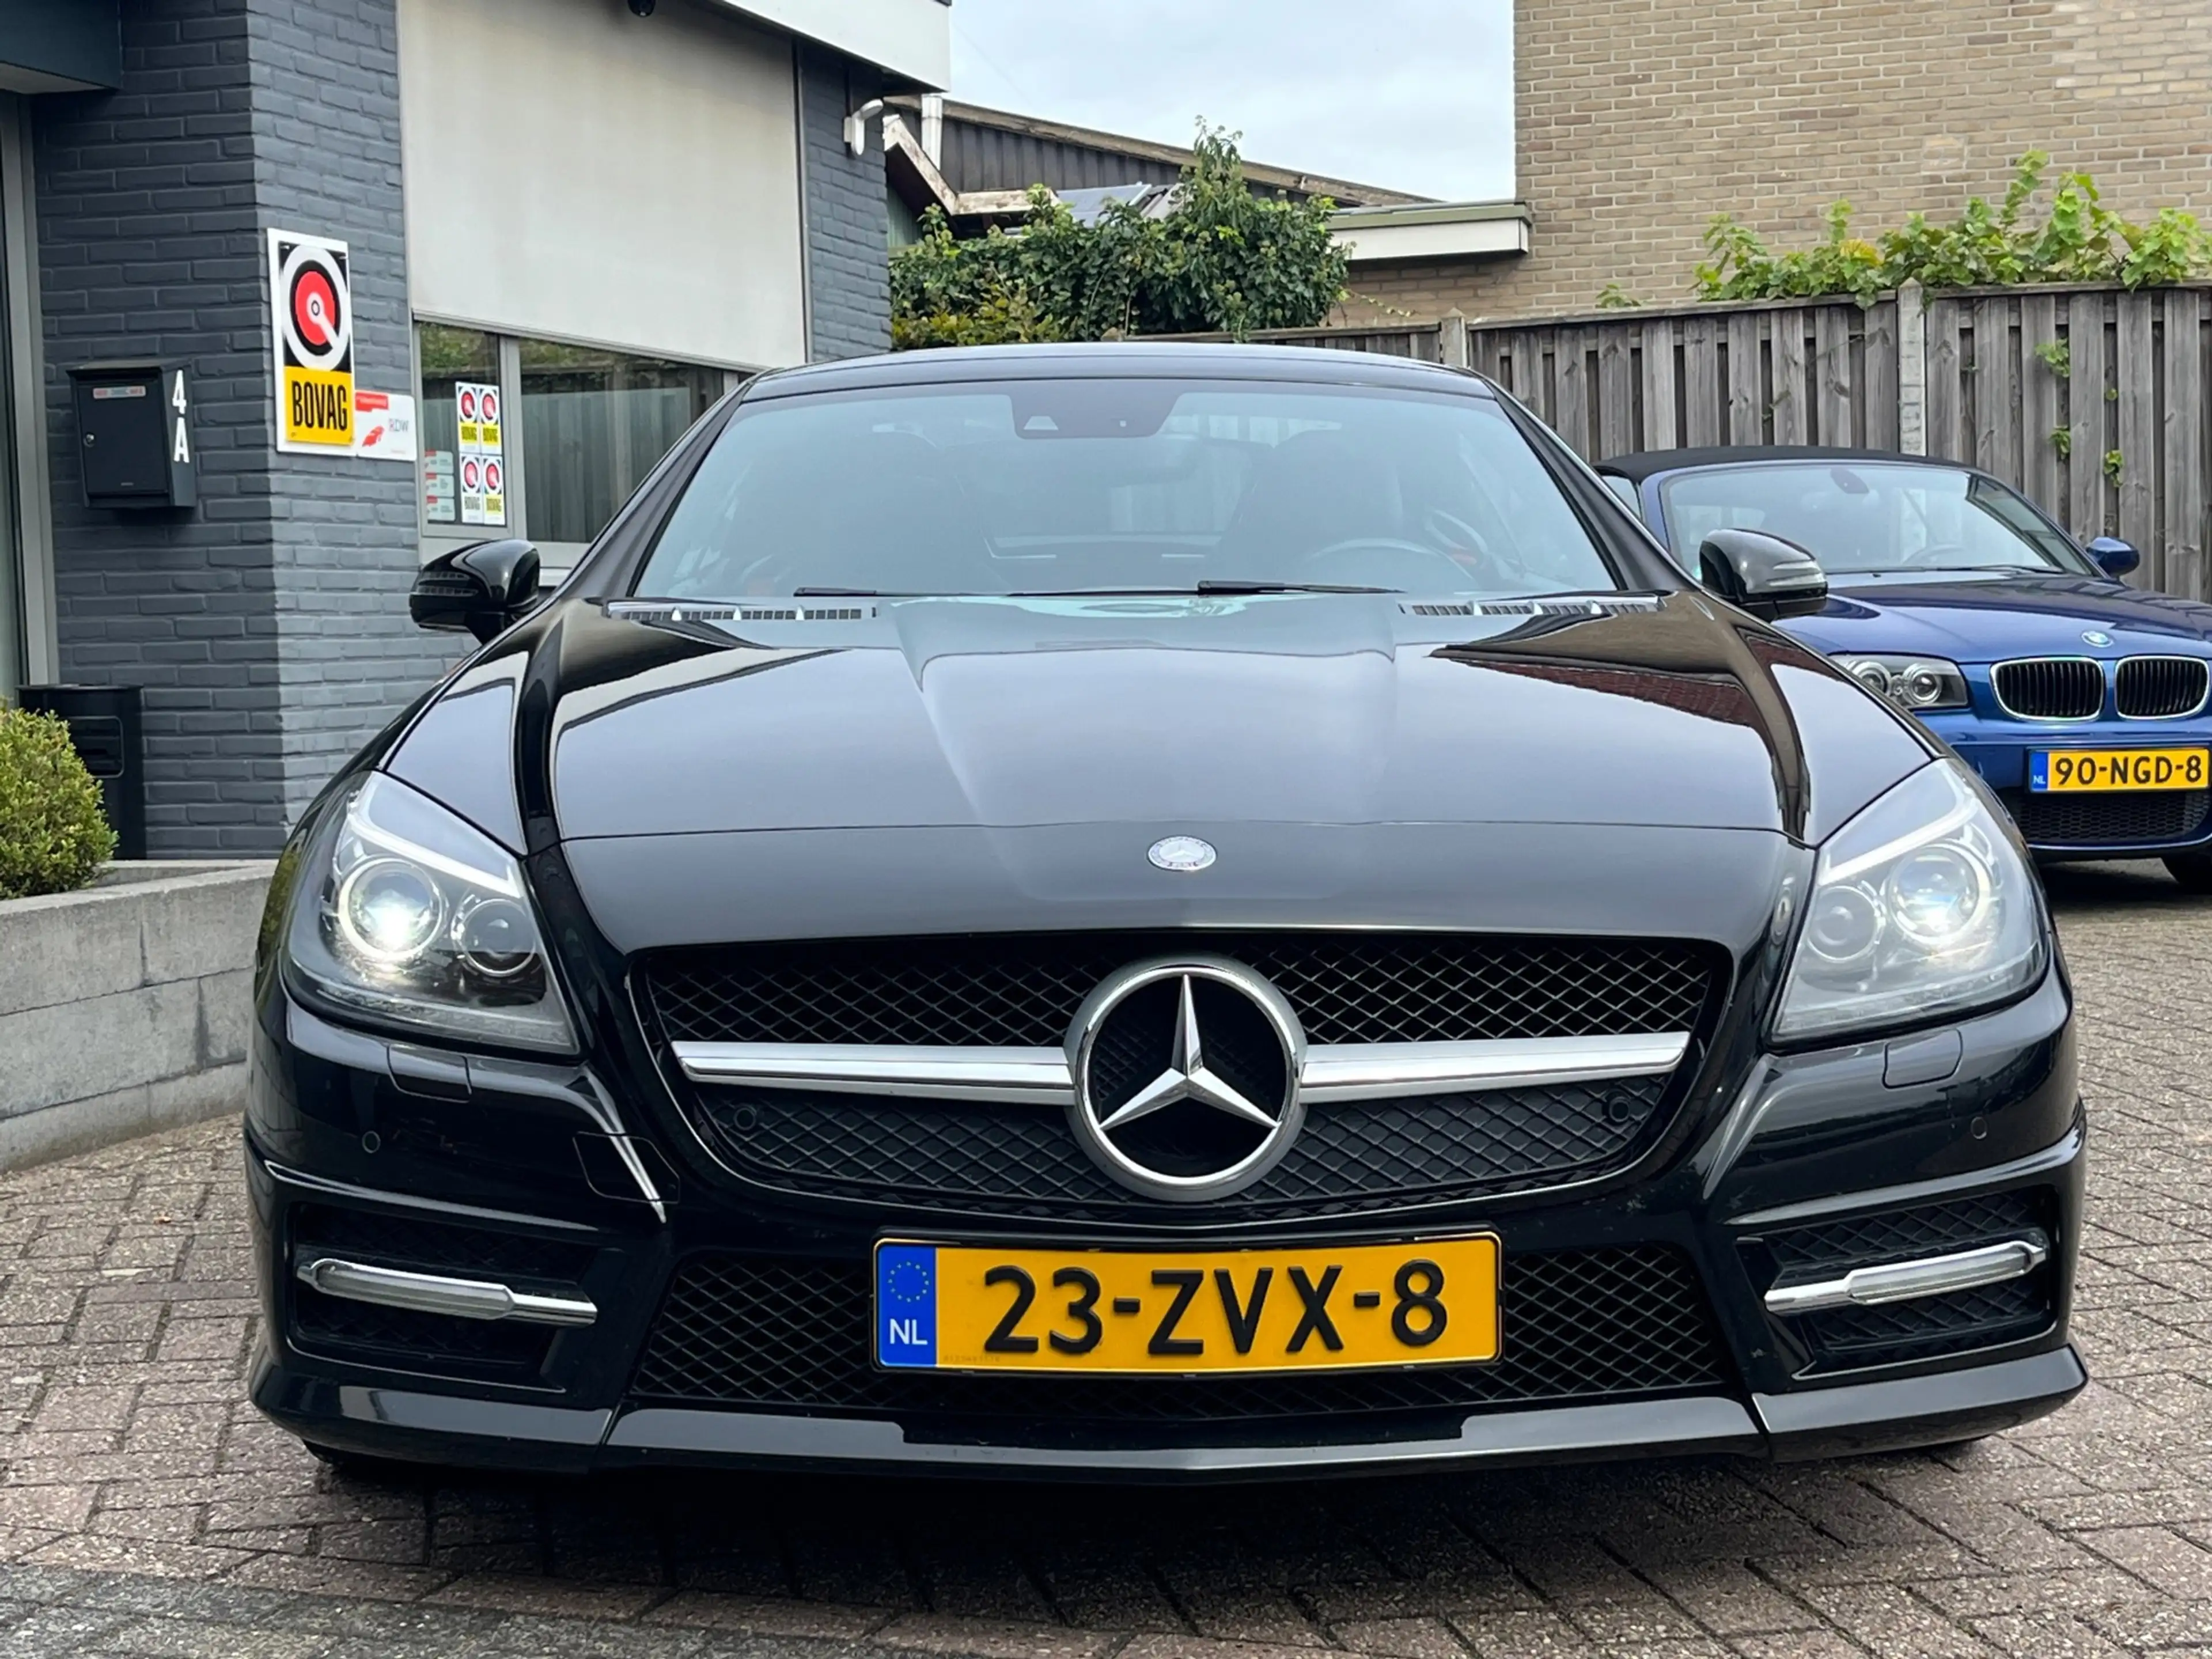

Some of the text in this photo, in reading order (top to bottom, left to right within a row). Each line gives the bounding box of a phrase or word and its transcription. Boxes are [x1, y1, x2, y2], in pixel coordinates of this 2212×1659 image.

[291, 380, 348, 431] BOVAG
[388, 418, 410, 432] RDW
[2033, 775, 2046, 785] NL
[2055, 755, 2202, 786] 90-NGD-8
[983, 1258, 1448, 1355] 23-ZVX-8
[889, 1318, 929, 1346] NL
